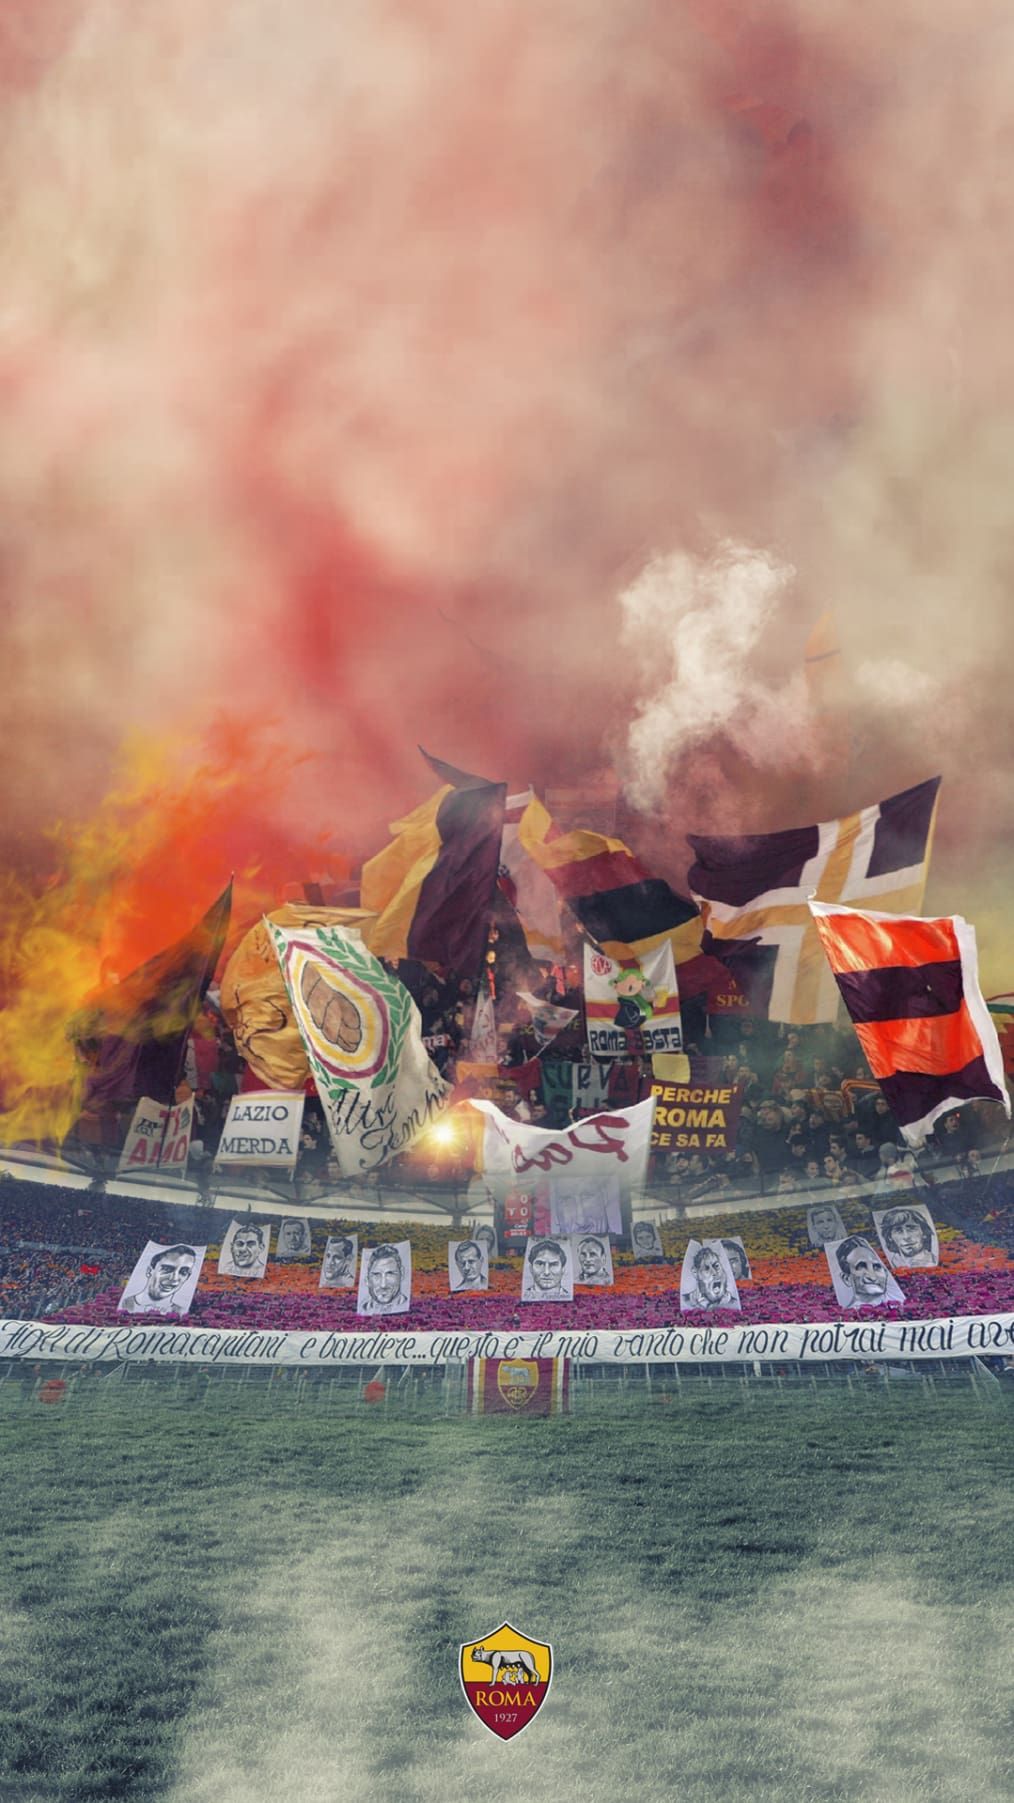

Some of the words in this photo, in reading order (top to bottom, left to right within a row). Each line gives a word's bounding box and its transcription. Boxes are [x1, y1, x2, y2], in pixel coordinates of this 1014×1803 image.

[651, 1084, 738, 1105] PERCHE'
[231, 1105, 289, 1122] LAZIO
[653, 1105, 727, 1129] ROMA
[127, 1135, 188, 1166] AMO
[220, 1136, 293, 1155] MERDA
[675, 1133, 700, 1149] SA
[705, 1133, 728, 1149] FA
[299, 1336, 317, 1358] e
[530, 1331, 553, 1359] il
[556, 1332, 599, 1359] mio
[613, 1327, 685, 1357] vanto
[689, 1328, 729, 1356] che
[736, 1328, 790, 1355] non
[799, 1322, 886, 1358] potrai
[899, 1319, 955, 1352] mai
